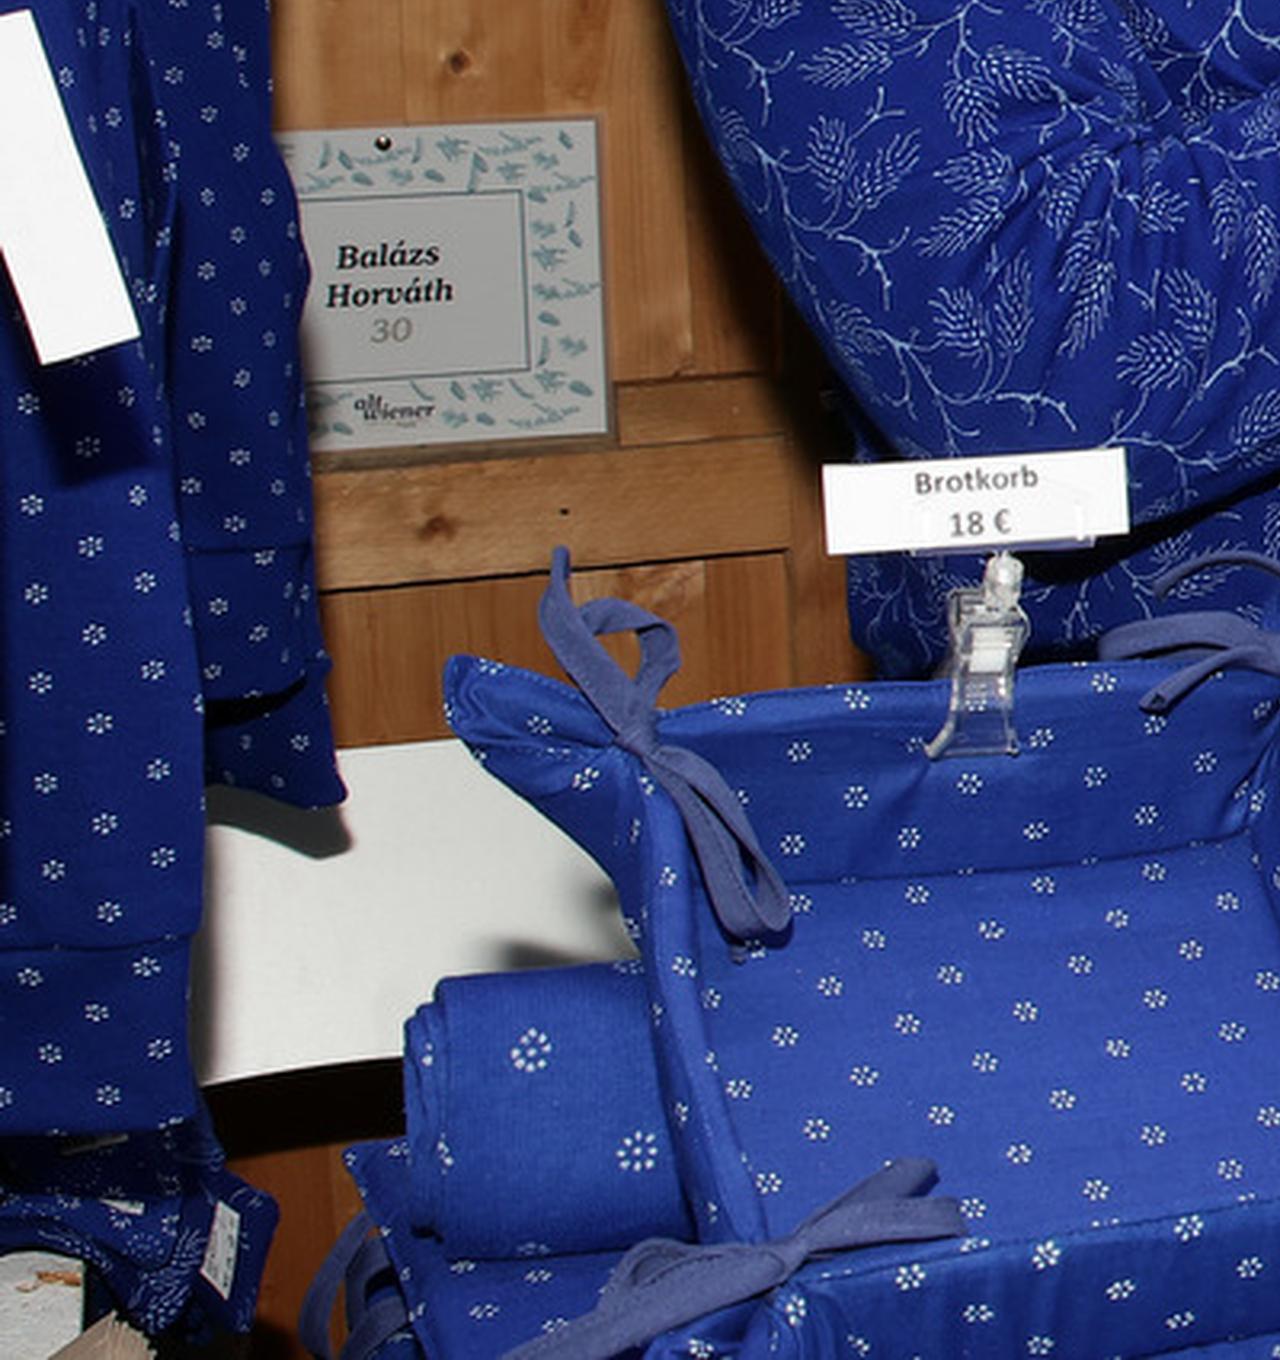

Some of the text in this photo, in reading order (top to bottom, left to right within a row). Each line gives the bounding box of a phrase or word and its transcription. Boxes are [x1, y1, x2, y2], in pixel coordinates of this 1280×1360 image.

[337, 239, 440, 270] Balázs
[326, 277, 453, 308] Horváth
[370, 316, 413, 343] 30
[914, 464, 1039, 495] Brotkorb
[950, 508, 1011, 538] 18 €
